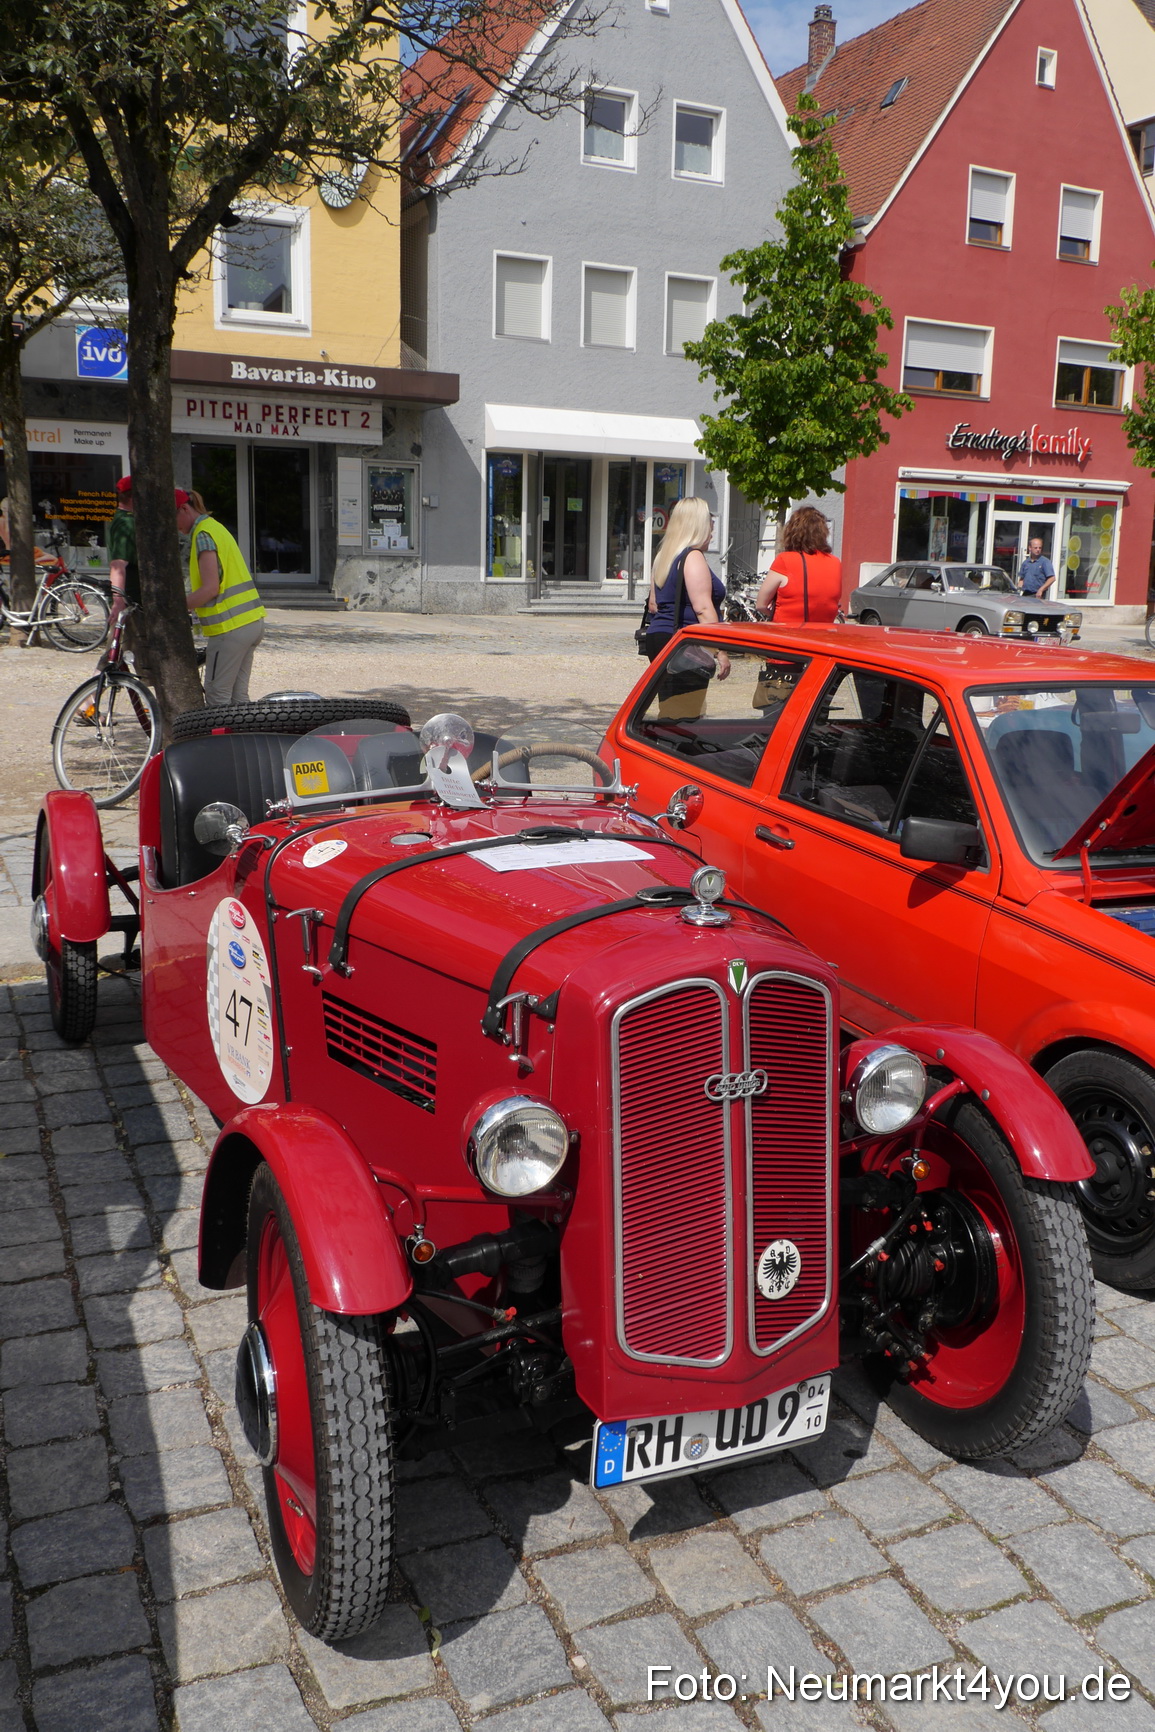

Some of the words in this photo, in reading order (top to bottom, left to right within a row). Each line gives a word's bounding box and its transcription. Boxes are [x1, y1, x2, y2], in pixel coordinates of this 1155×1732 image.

[231, 361, 376, 390] Bavaria-Kino
[186, 399, 248, 420] PITCH
[262, 405, 350, 427] PERFECT
[360, 411, 370, 429] 2
[73, 429, 112, 437] Permanent
[234, 422, 262, 434] MAD
[271, 425, 300, 437] MAX
[949, 422, 1029, 460] Ernsting's
[1029, 424, 1092, 467] family
[295, 761, 325, 776] ADAC
[225, 989, 253, 1047] 47
[807, 1383, 825, 1399] 04
[806, 1415, 822, 1430] 10
[625, 1415, 684, 1473] RH
[715, 1398, 769, 1451] UD
[777, 1391, 800, 1438] 9
[604, 1459, 615, 1474] D
